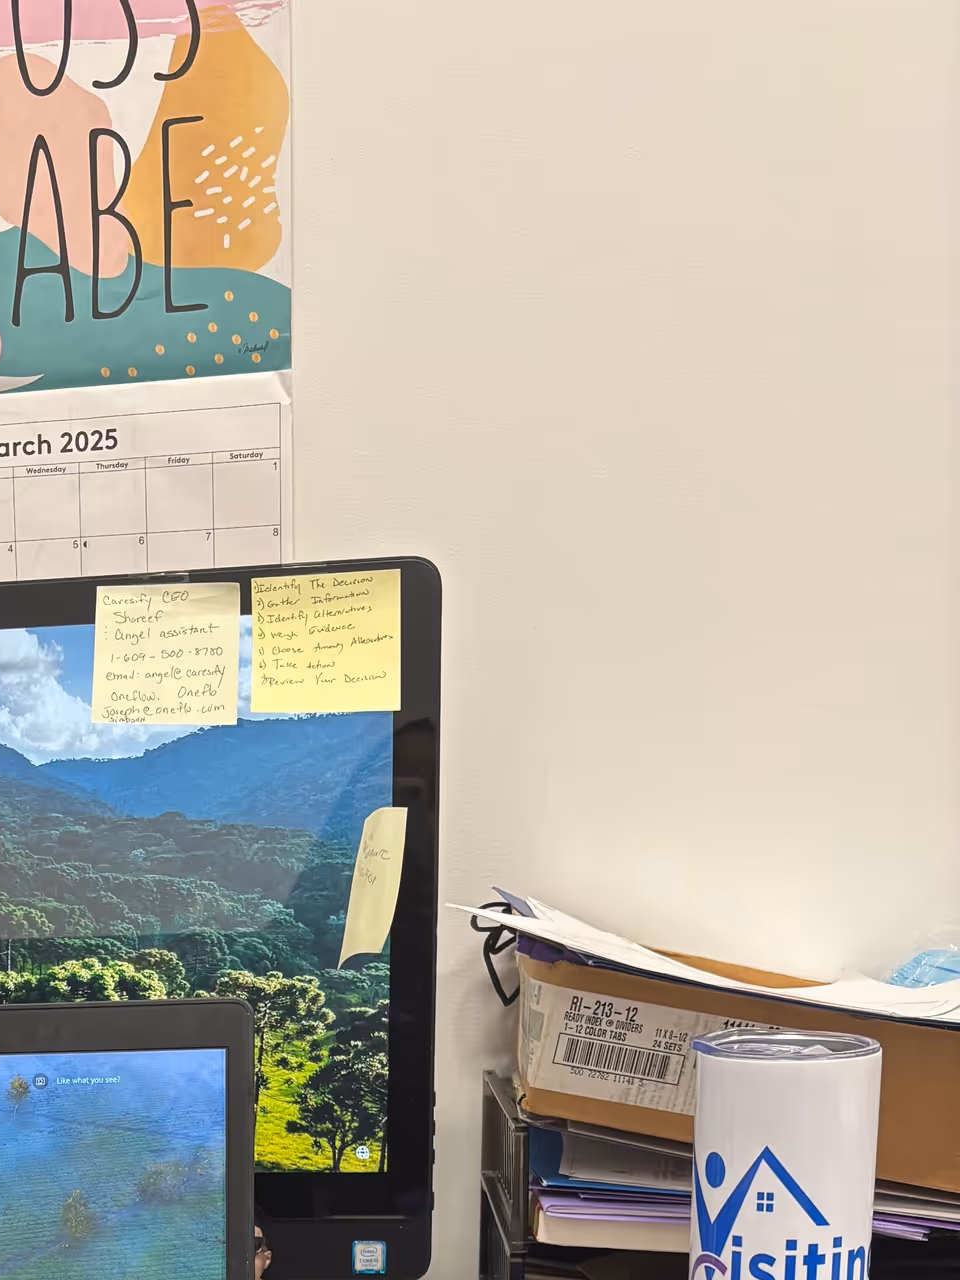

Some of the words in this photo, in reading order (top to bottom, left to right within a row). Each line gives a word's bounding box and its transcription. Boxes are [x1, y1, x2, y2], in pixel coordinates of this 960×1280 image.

[59, 427, 119, 454] 2025
[26, 464, 67, 476] Wednesday
[95, 460, 130, 471] Thursday
[167, 455, 191, 466] Friday
[229, 450, 264, 461] Saturday
[272, 461, 279, 471] 1
[7, 544, 14, 554] 4
[72, 540, 79, 549] 5
[138, 536, 145, 545] 6
[205, 531, 212, 541] 7
[272, 527, 279, 537] 8
[309, 578, 327, 590] The
[332, 576, 374, 588] Decision
[161, 590, 190, 604] CEO
[311, 588, 370, 605] Information
[159, 623, 220, 639] assistant
[563, 1010, 585, 1024] READY
[584, 1015, 603, 1027] INDEX
[615, 1019, 644, 1034] DIVIDERS
[583, 1025, 607, 1039] COLOR
[608, 1030, 628, 1043] TABS
[654, 1027, 662, 1038] 11
[651, 1039, 662, 1049] 24
[663, 1040, 683, 1053] SETS
[56, 1076, 71, 1085] Like
[71, 1076, 90, 1085] what
[90, 1077, 104, 1086] you
[104, 1075, 121, 1084] see?
